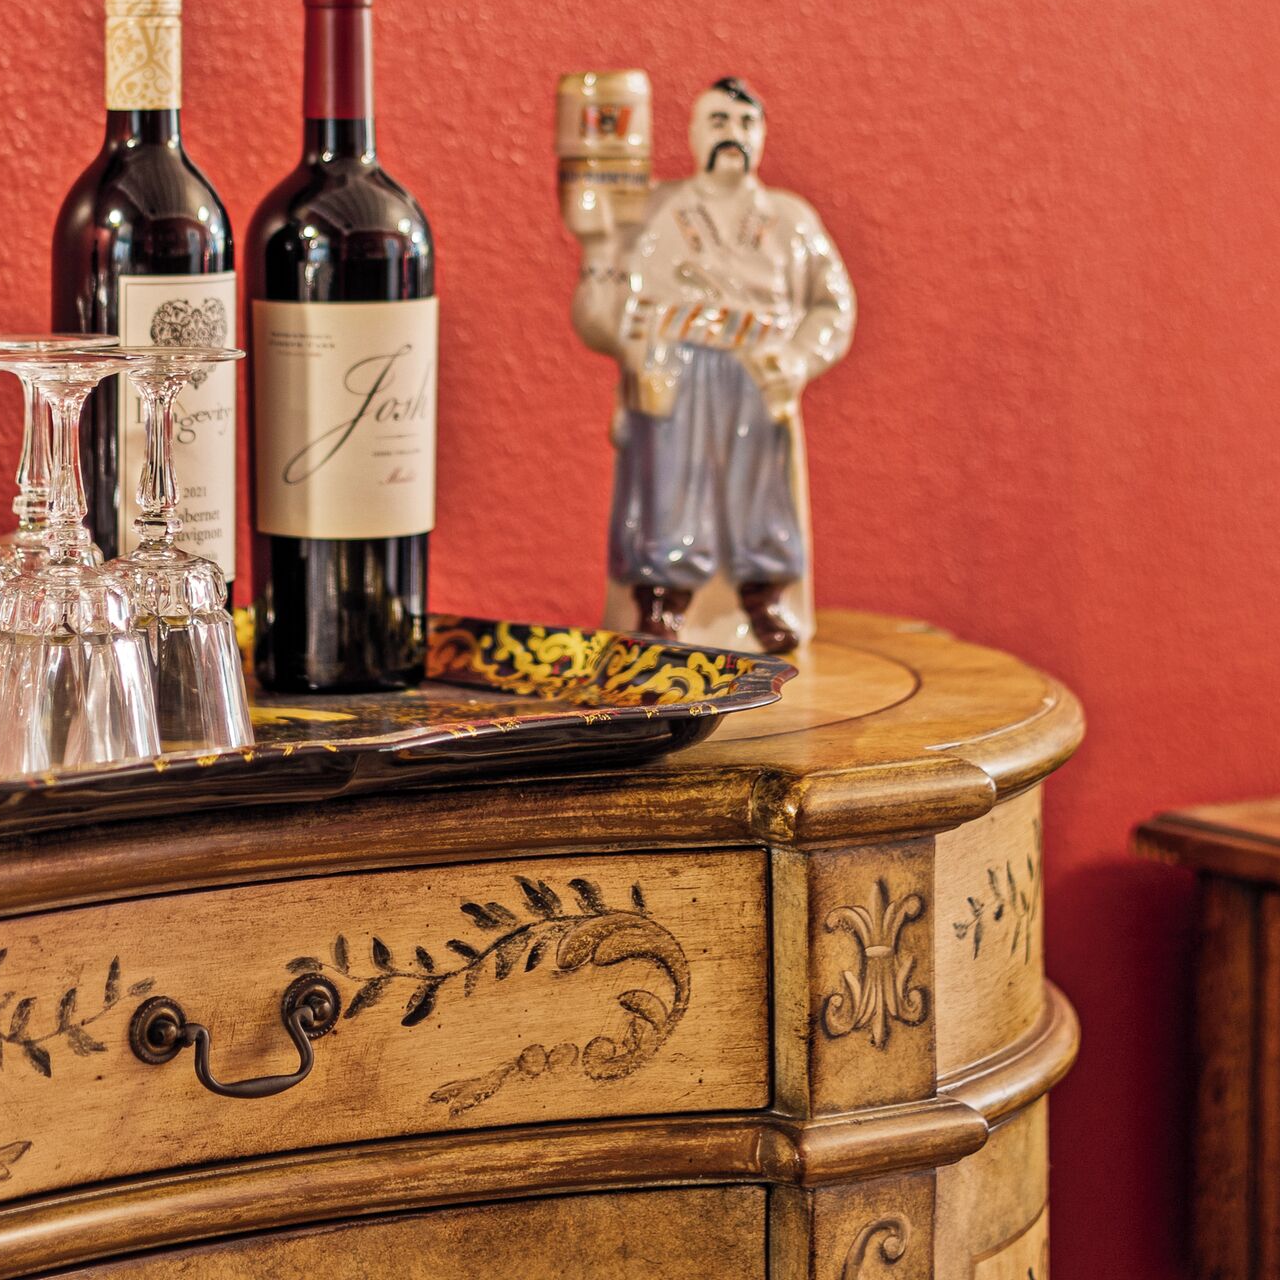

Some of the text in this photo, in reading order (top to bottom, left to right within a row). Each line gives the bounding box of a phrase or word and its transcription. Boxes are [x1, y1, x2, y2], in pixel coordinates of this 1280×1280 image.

[136, 396, 232, 444] Lgevity
[283, 343, 432, 485] Josh
[183, 486, 207, 499] 2021
[176, 507, 220, 524] abernet
[175, 527, 224, 546] uvignon
